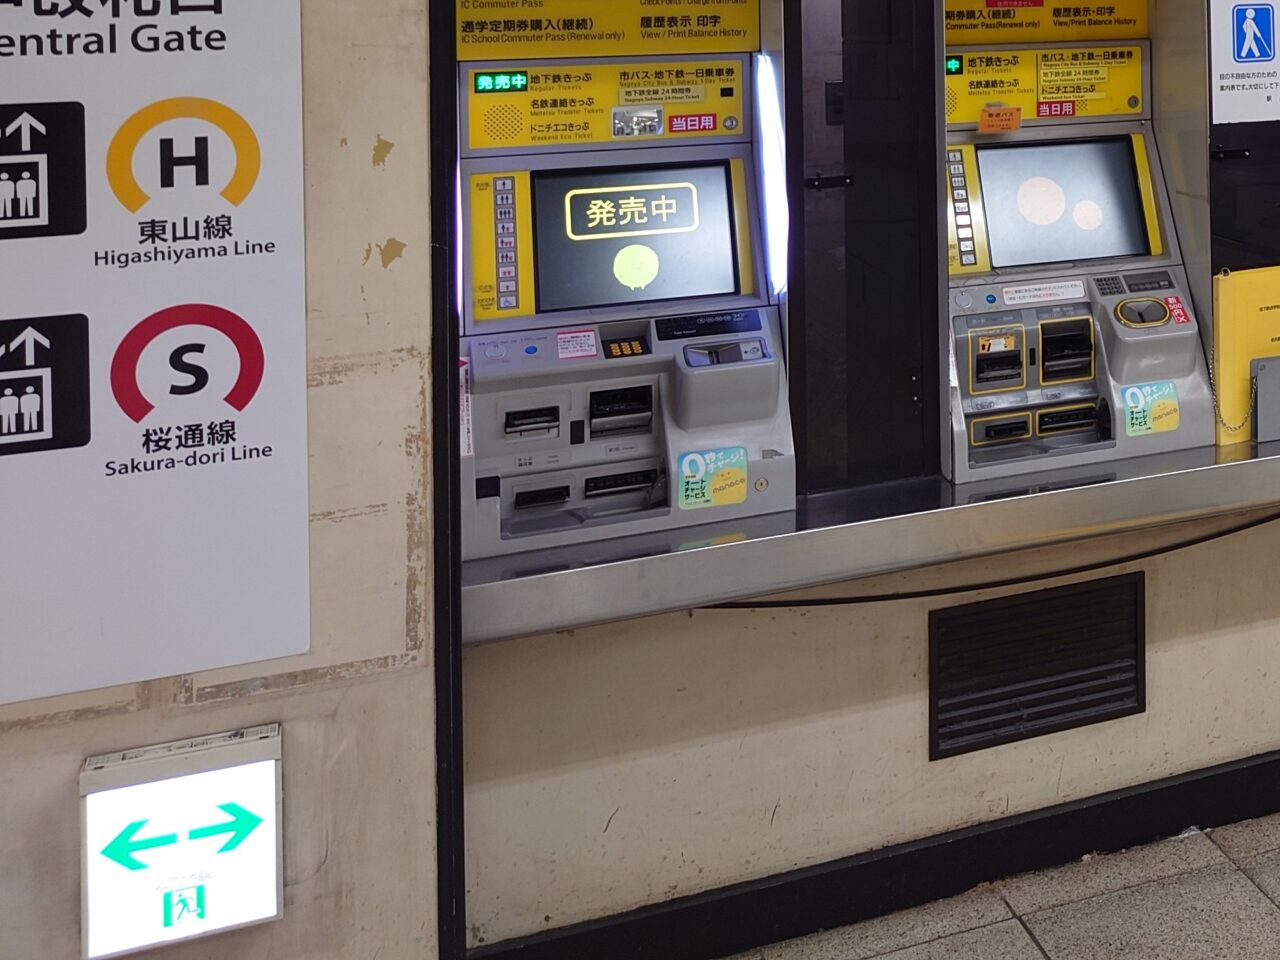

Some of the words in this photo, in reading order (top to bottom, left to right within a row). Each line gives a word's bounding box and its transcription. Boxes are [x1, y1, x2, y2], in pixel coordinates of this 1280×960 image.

[461, 17, 594, 33] 通学定期券購入(継続)
[640, 15, 692, 29] 履歴表示
[697, 14, 721, 27] 印字
[131, 23, 227, 53] Gate
[968, 55, 1020, 68] 地下鉄きっぷ
[477, 74, 528, 90] 発売中
[530, 71, 593, 85] 地下鉄きっぷ
[619, 67, 736, 82] 市バス・地下鉄一日乗車券
[1219, 70, 1278, 81] 目の不自由な方のための
[968, 78, 1020, 90] 名鉄連絡きっぷ
[530, 96, 595, 109] 名鉄連絡きっぷ
[1039, 103, 1073, 116] 当日用
[671, 116, 715, 132] 当日用
[159, 136, 210, 188] H
[586, 196, 677, 228] 発売中
[138, 214, 233, 244] 東山線
[94, 244, 228, 268] Higashiyama
[234, 240, 276, 256] Line
[169, 343, 209, 396] S
[142, 419, 238, 454] 桜通線
[105, 449, 226, 477] Sakura-dori
[231, 443, 273, 461] Line
